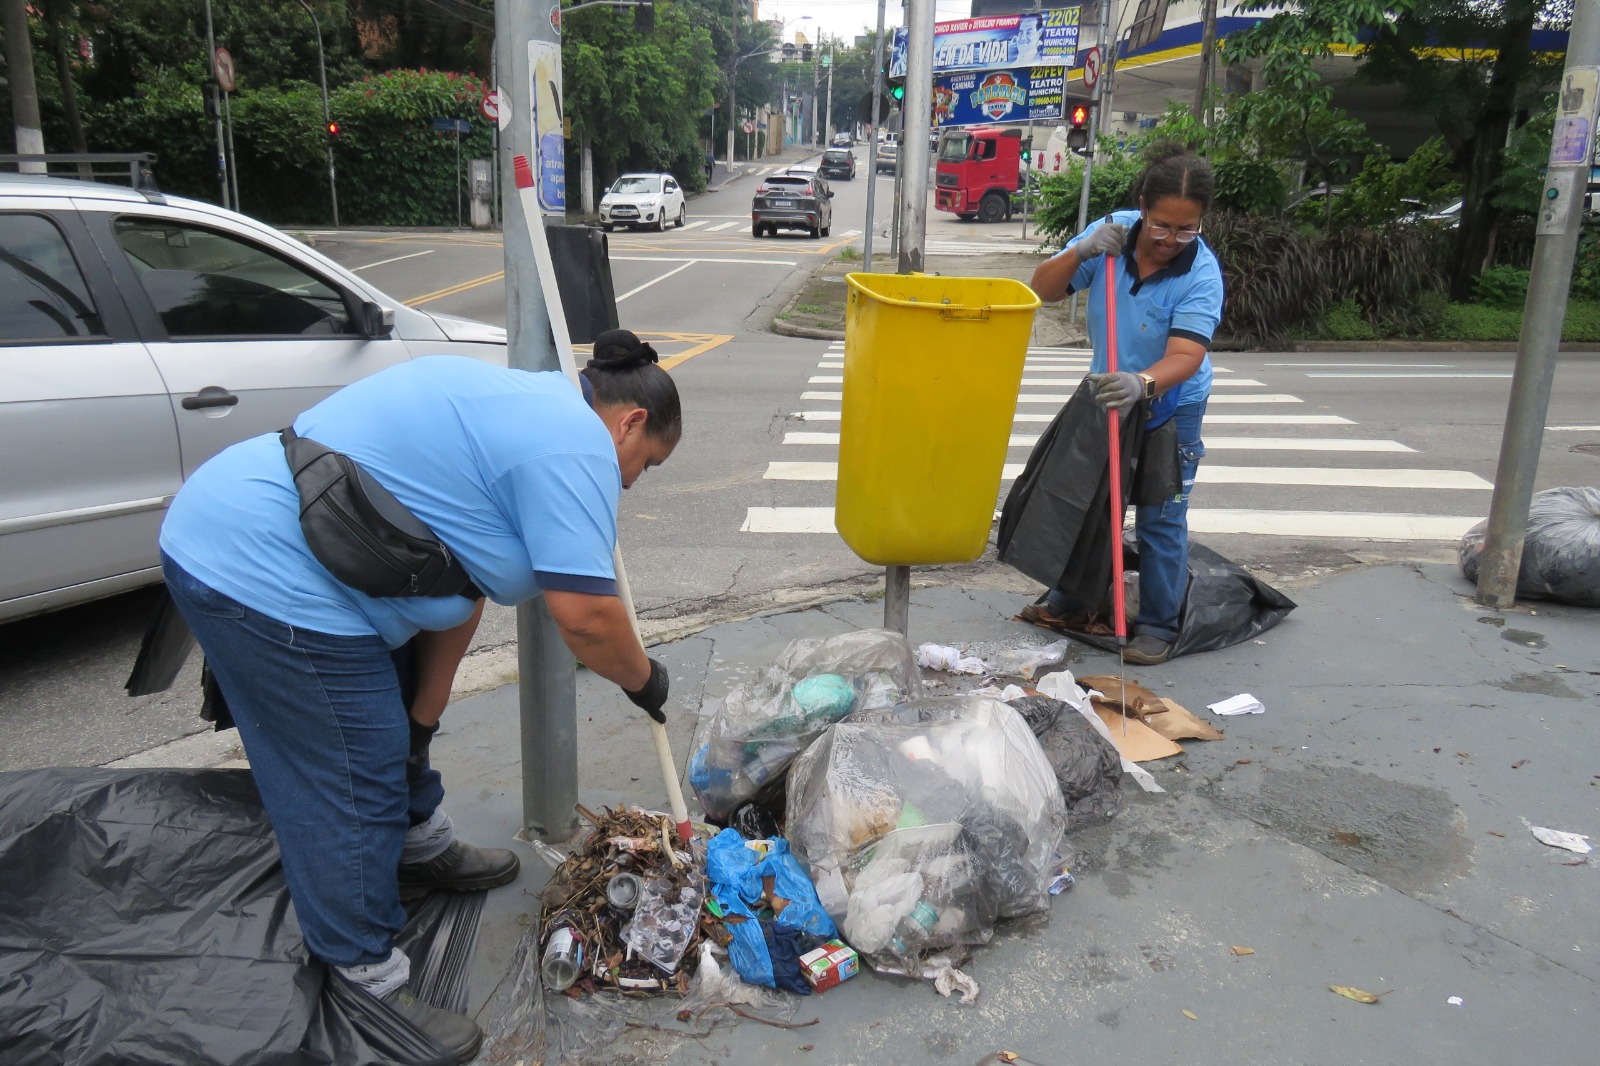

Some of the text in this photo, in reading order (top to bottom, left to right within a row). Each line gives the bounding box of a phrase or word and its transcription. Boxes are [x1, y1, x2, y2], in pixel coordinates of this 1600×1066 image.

[1047, 9, 1079, 27] 22/02
[934, 24, 950, 33] CHICO
[950, 21, 969, 31] XAVIER
[973, 19, 996, 29] DIVALDO
[996, 17, 1019, 27] FRANCO
[1045, 27, 1078, 37] TEATRO
[1043, 37, 1077, 47] MUNICIPAL
[933, 39, 1009, 67] LÉM DA VIDA
[1030, 66, 1063, 79] 22/FEV
[951, 80, 975, 91] CANINAS
[1030, 78, 1063, 89] TEATRO
[1029, 88, 1062, 97] MUNICIPAL
